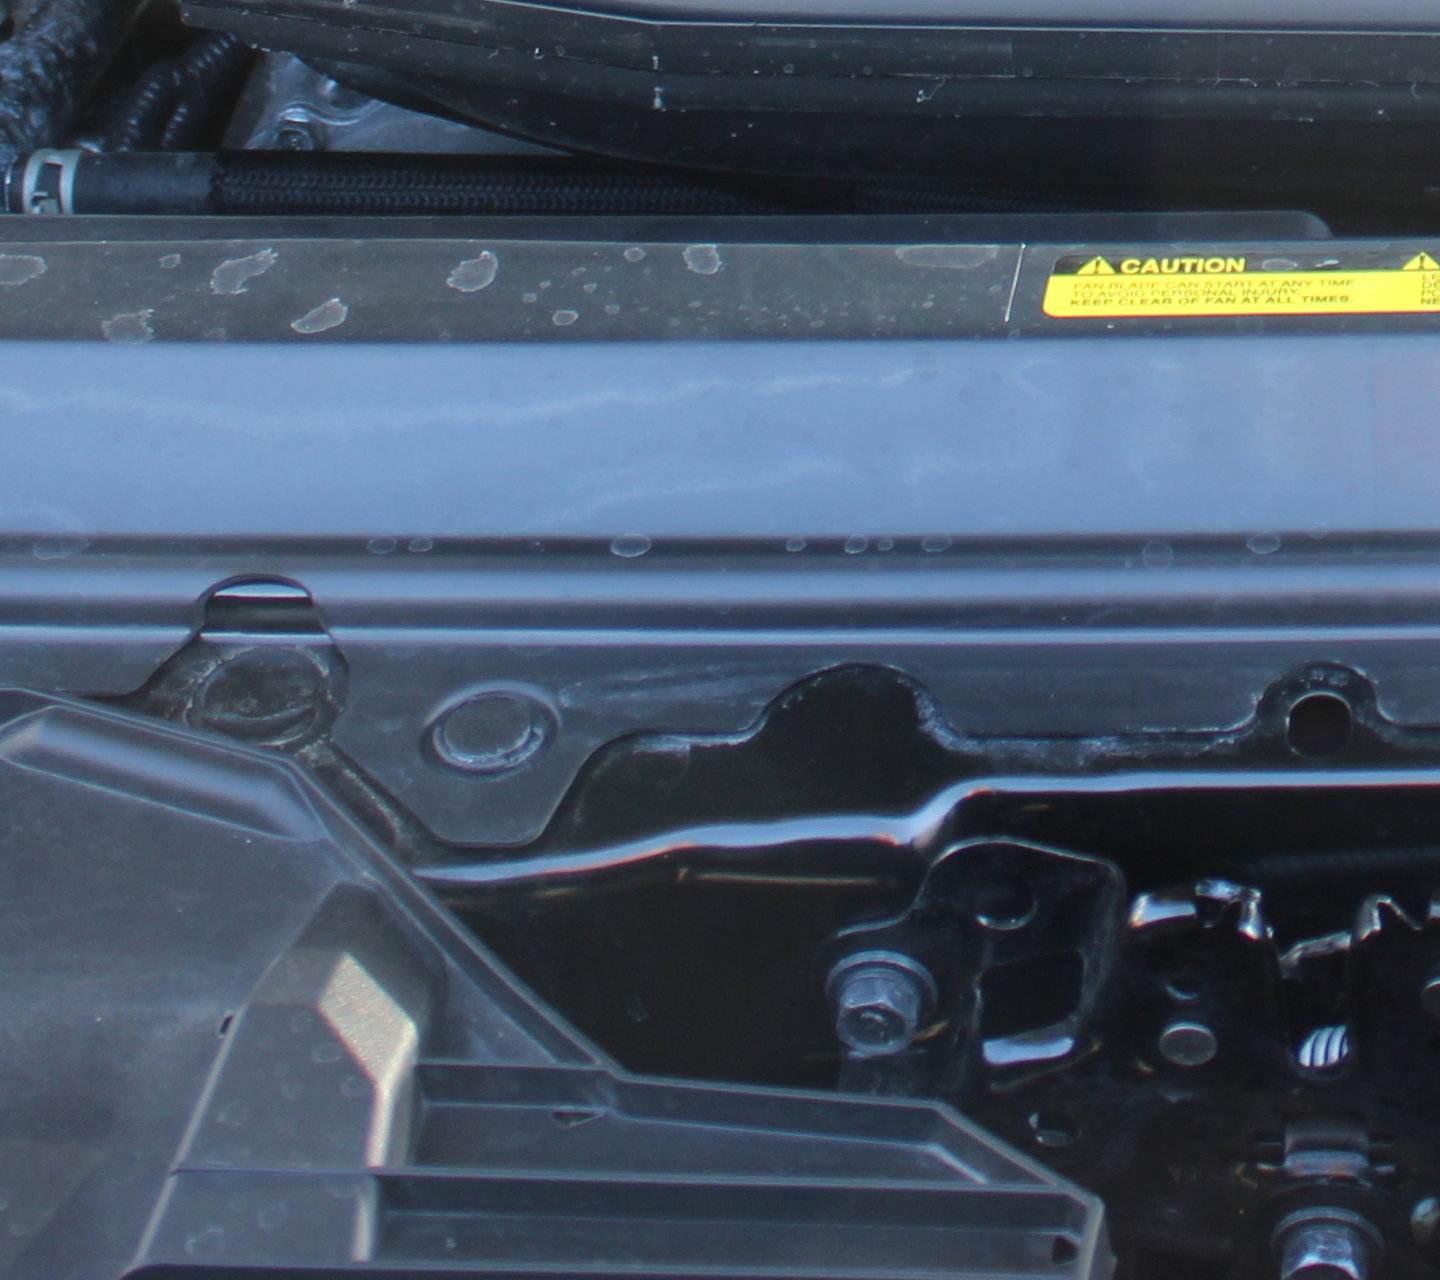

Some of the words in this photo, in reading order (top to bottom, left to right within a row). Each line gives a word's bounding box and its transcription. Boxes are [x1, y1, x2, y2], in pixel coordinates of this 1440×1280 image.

[1120, 257, 1245, 275] CAUTION
[1422, 273, 1440, 281] LE
[1073, 281, 1104, 290] FAN
[1109, 281, 1160, 290] BLADE
[1165, 281, 1199, 289] CAN
[1205, 280, 1253, 289] START
[1258, 280, 1275, 288] AT
[1281, 280, 1313, 288] ANY
[1319, 279, 1355, 287] TIME
[1073, 290, 1094, 298] TO
[1100, 290, 1145, 298] AVOID
[1150, 289, 1237, 298] PERSONAL
[1070, 298, 1113, 306] KEEP
[1118, 298, 1172, 306] CLEAR
[1179, 298, 1200, 306] OF
[1205, 297, 1237, 305] FAN
[1241, 296, 1260, 304] AT
[1265, 296, 1293, 304] ALL
[1302, 295, 1353, 304] TIMES.
[1420, 297, 1440, 306] NE
